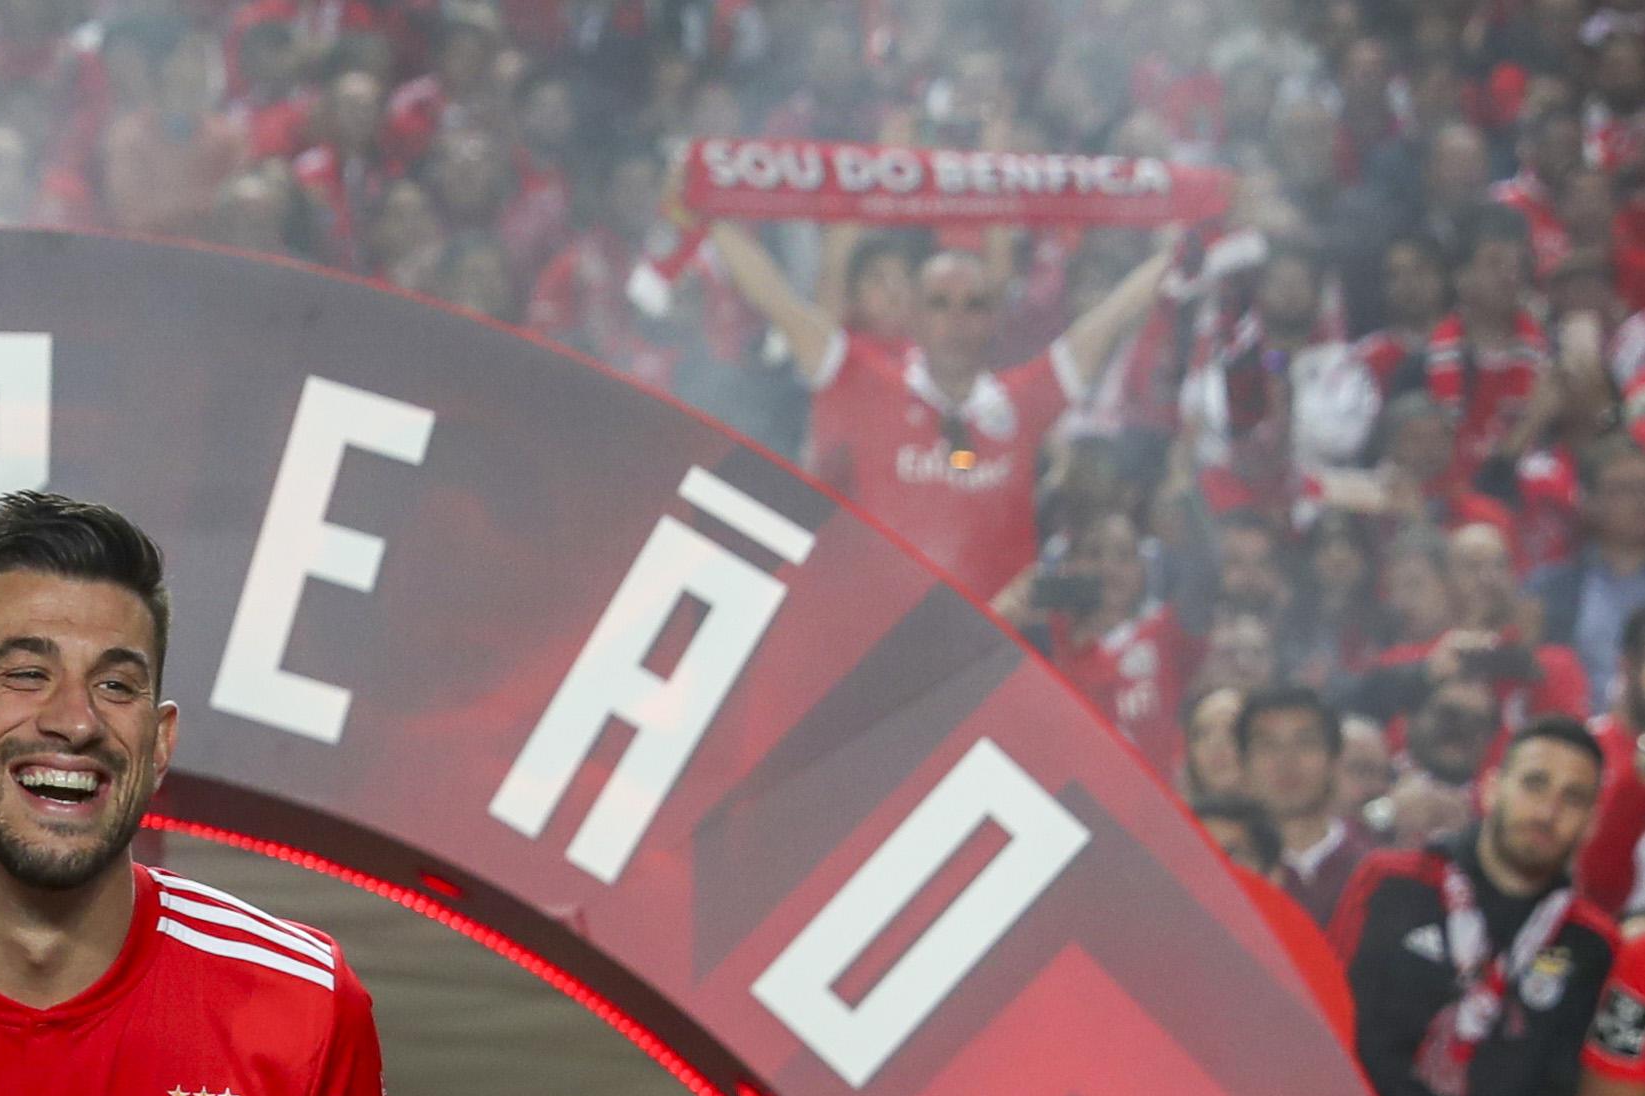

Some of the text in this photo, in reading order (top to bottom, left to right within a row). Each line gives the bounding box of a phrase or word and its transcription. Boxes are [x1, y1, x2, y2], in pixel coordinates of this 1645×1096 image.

[702, 141, 1172, 196] SOU DO BENFICA
